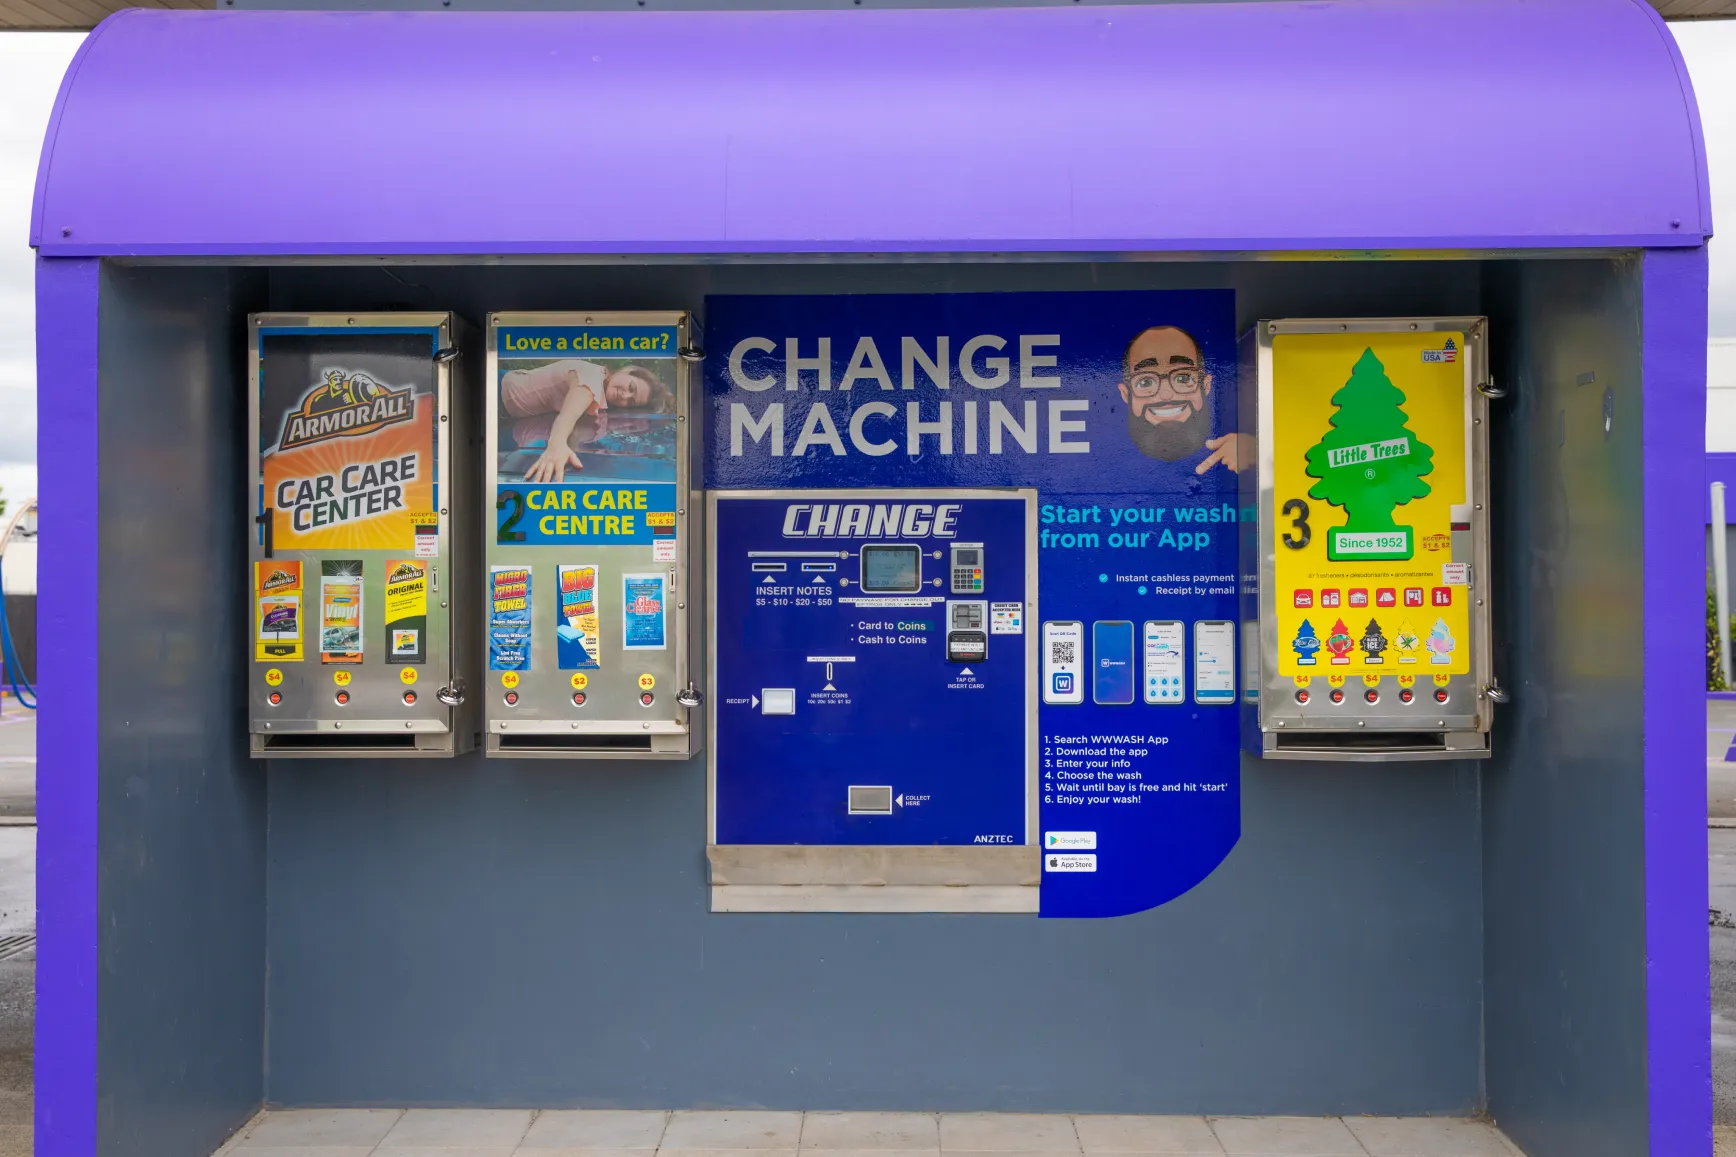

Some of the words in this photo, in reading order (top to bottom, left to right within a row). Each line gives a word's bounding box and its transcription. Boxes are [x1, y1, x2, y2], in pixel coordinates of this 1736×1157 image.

[506, 333, 552, 350] Love
[557, 338, 567, 350] a
[573, 333, 625, 350] clean
[629, 333, 670, 350] car?
[728, 333, 1061, 393] CHANGE
[729, 399, 1091, 457] MACHINE
[1333, 446, 1367, 465] Little
[1371, 442, 1406, 460] Trees
[277, 475, 334, 509] CAR
[341, 455, 416, 495] CARE
[526, 490, 577, 510] CAR
[582, 490, 648, 510] CARE
[293, 485, 403, 532] CENTER
[496, 490, 526, 542] 2
[1041, 504, 1101, 523] Start
[1110, 507, 1166, 527] your
[1174, 503, 1236, 523] wash
[539, 515, 635, 535] CENTRE
[782, 504, 962, 539] CHANGE
[1282, 499, 1312, 550] 3
[256, 507, 273, 558] 1
[1040, 529, 1100, 548] from
[1108, 531, 1150, 548] our
[1158, 529, 1210, 551] App
[1339, 538, 1373, 548] Since
[1375, 538, 1403, 548] 1952
[494, 569, 528, 585] MICRO
[562, 567, 594, 592] BIG
[1193, 575, 1235, 583] payment
[387, 582, 423, 596] ORIGINAL
[494, 583, 527, 600] FIBER
[756, 587, 795, 595] INSERT
[797, 587, 832, 595] NOTES
[1155, 587, 1192, 595] Receipt
[1194, 587, 1206, 595] by
[1209, 586, 1235, 594] email
[563, 590, 593, 606] BLUE
[636, 595, 660, 607] Glass
[755, 598, 766, 606] $5
[773, 598, 788, 606] $10
[795, 598, 810, 606] $20
[818, 598, 833, 606] $50
[494, 597, 527, 613] TOWEL
[563, 603, 595, 617] TOWEL
[626, 602, 662, 613] Cleaner
[858, 621, 882, 629] Card
[884, 622, 894, 630] to
[897, 622, 926, 630] Coins
[898, 636, 927, 644] Coins
[269, 673, 280, 681] $4
[337, 673, 349, 682] $4
[403, 671, 415, 680] $4
[505, 675, 517, 684] $4
[1400, 675, 1412, 683] $4
[574, 677, 585, 686] $2
[641, 678, 653, 686] $3
[1058, 680, 1068, 688] W
[1148, 736, 1169, 745] App
[1128, 749, 1148, 757] app
[1056, 759, 1083, 767] Enter
[1086, 761, 1109, 769] your
[1111, 759, 1131, 767] info
[1045, 771, 1054, 779] 4.
[1057, 771, 1094, 779] Choose
[1097, 771, 1114, 779] the
[1116, 771, 1142, 779] wash
[1045, 783, 1053, 791] 5.
[1057, 783, 1080, 791] Wait
[1082, 783, 1105, 791] until
[1107, 783, 1125, 792] bay
[1128, 783, 1137, 791] is
[1139, 783, 1159, 791] free
[1162, 783, 1181, 791] and
[1183, 783, 1197, 791] hit
[1045, 795, 1053, 803] 6.
[1057, 795, 1084, 804] Enjoy
[1113, 795, 1141, 803] wash!
[1061, 861, 1074, 869] App
